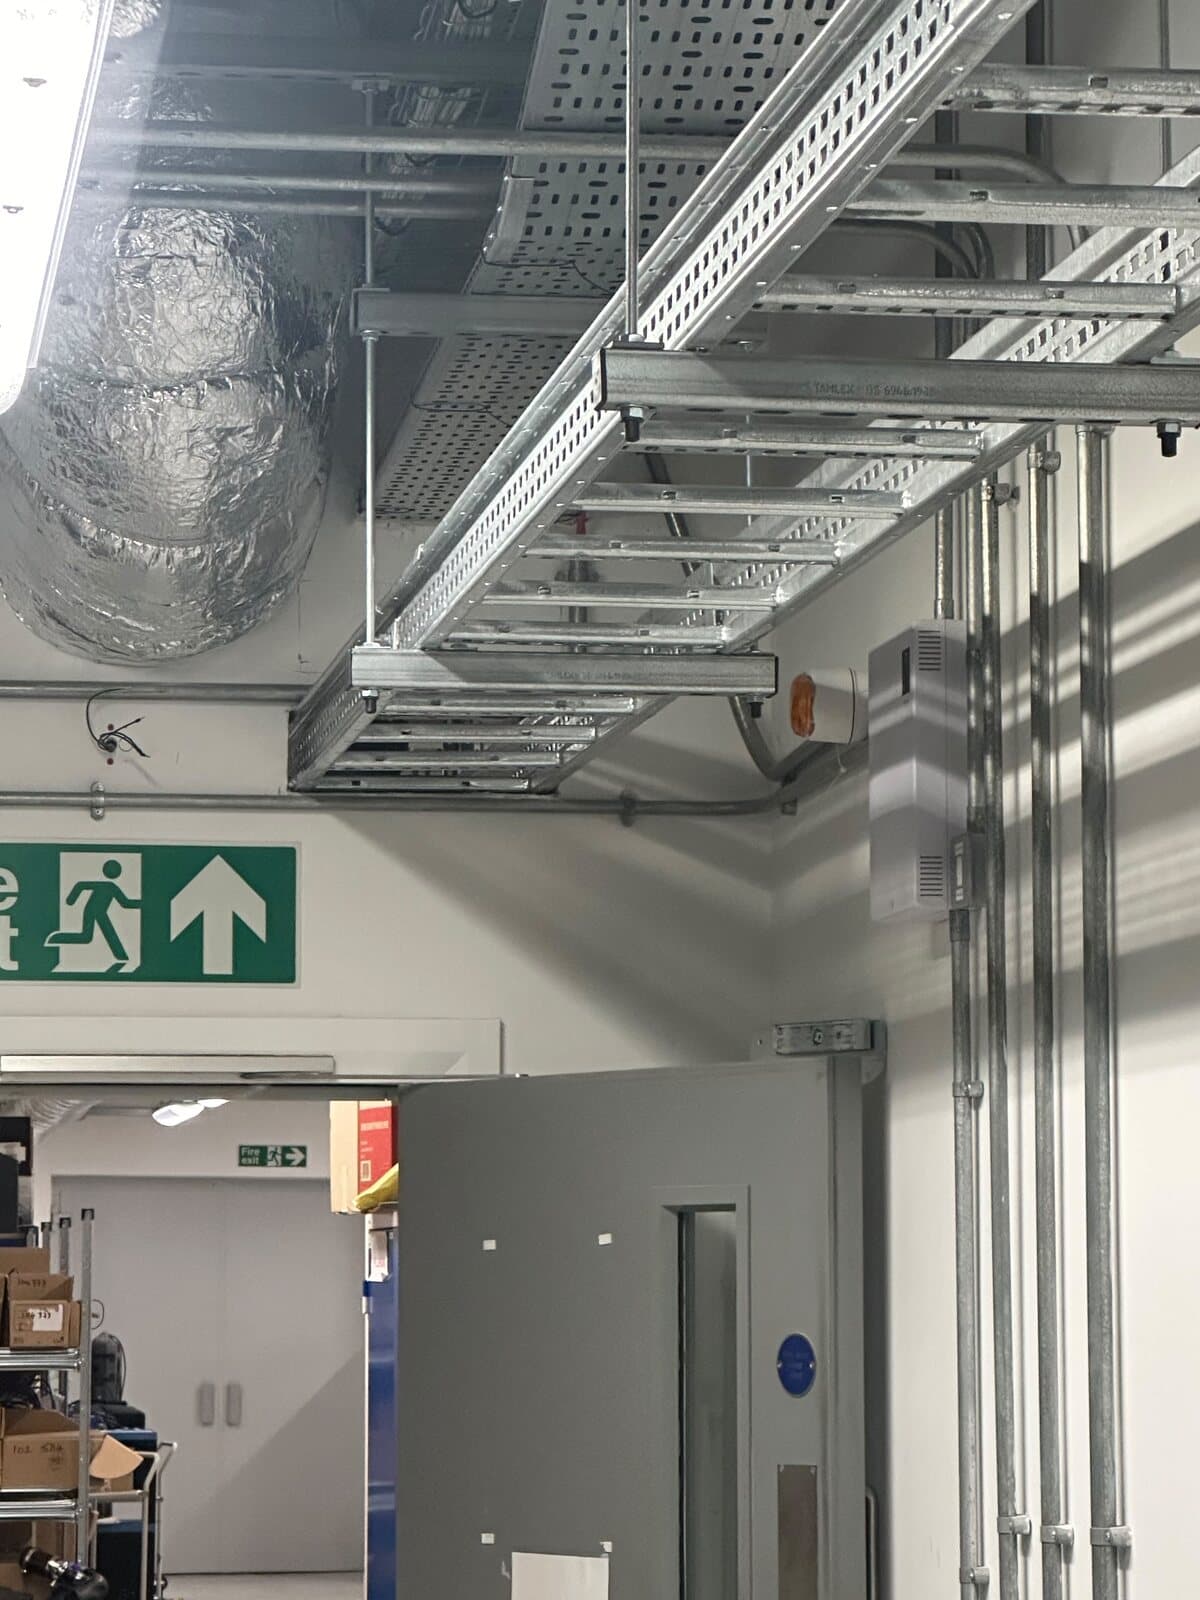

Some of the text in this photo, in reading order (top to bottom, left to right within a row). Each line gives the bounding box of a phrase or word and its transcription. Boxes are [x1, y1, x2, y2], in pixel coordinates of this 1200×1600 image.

[816, 382, 855, 394] TAMLEX
[241, 1147, 260, 1156] Fire
[241, 1157, 260, 1165] exit
